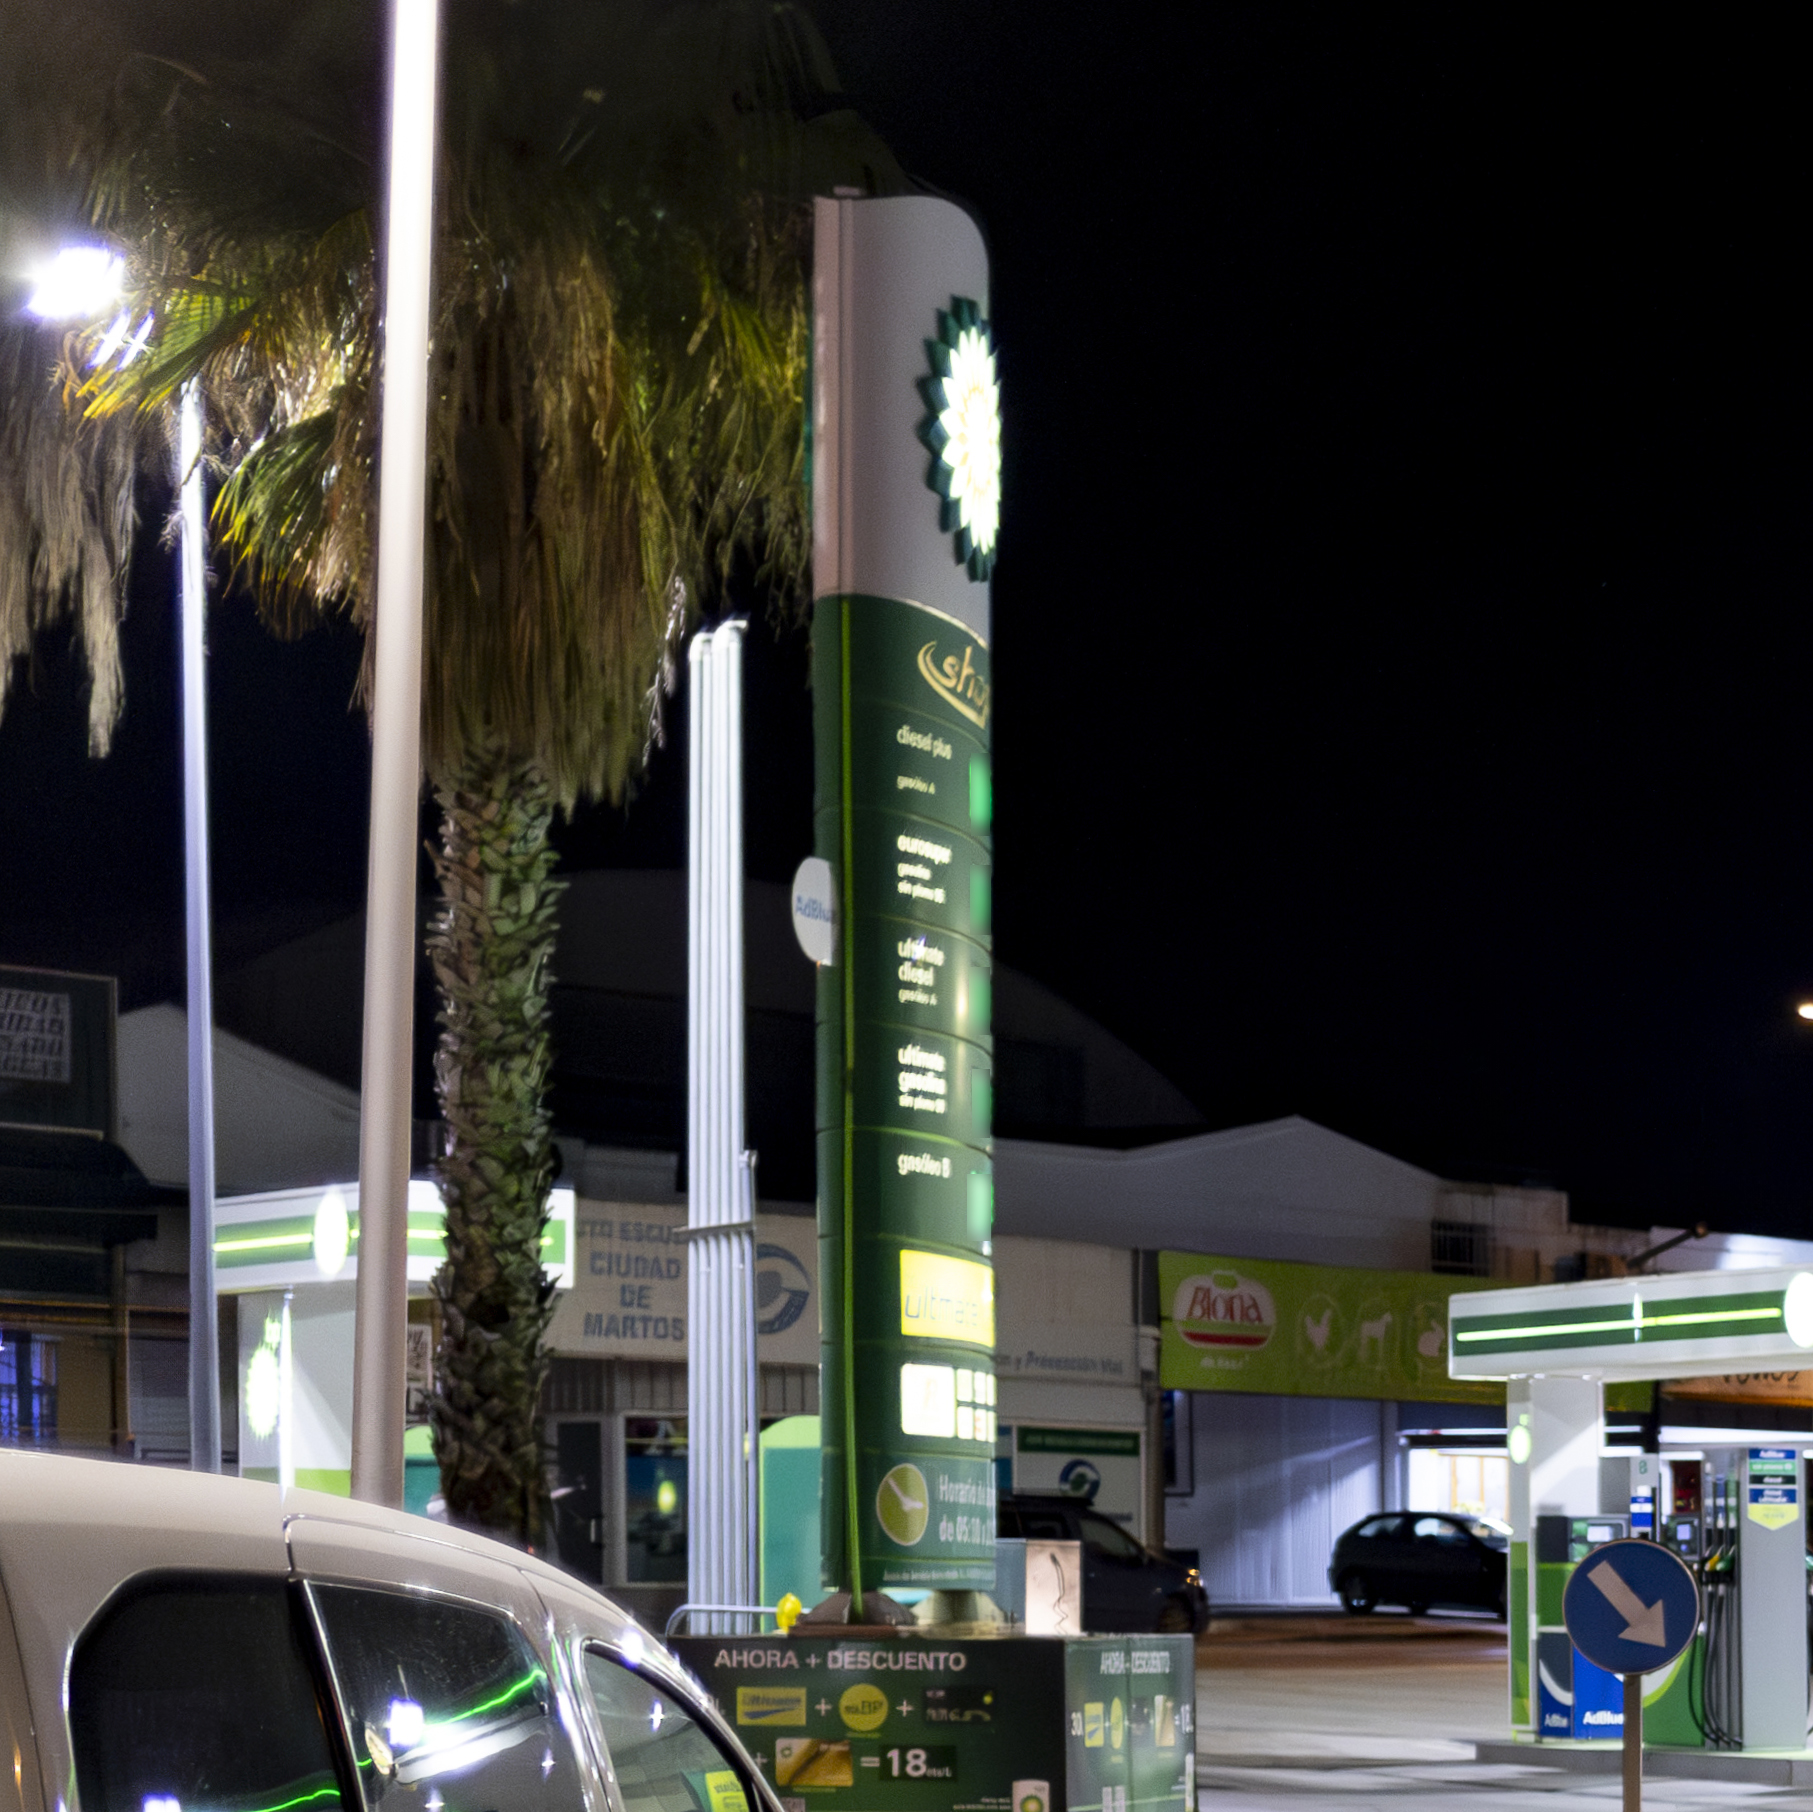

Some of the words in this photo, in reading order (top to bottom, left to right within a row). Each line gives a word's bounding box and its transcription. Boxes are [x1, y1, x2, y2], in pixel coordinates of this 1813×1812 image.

[899, 1044, 946, 1072] ultimate
[590, 1253, 681, 1279] CIUDAD
[620, 1284, 652, 1309] DE
[583, 1313, 685, 1341] MARTOS
[939, 1515, 954, 1542] de
[714, 1649, 800, 1669] AHORA
[827, 1651, 967, 1672] DESCUENTO
[886, 1748, 927, 1777] 18
